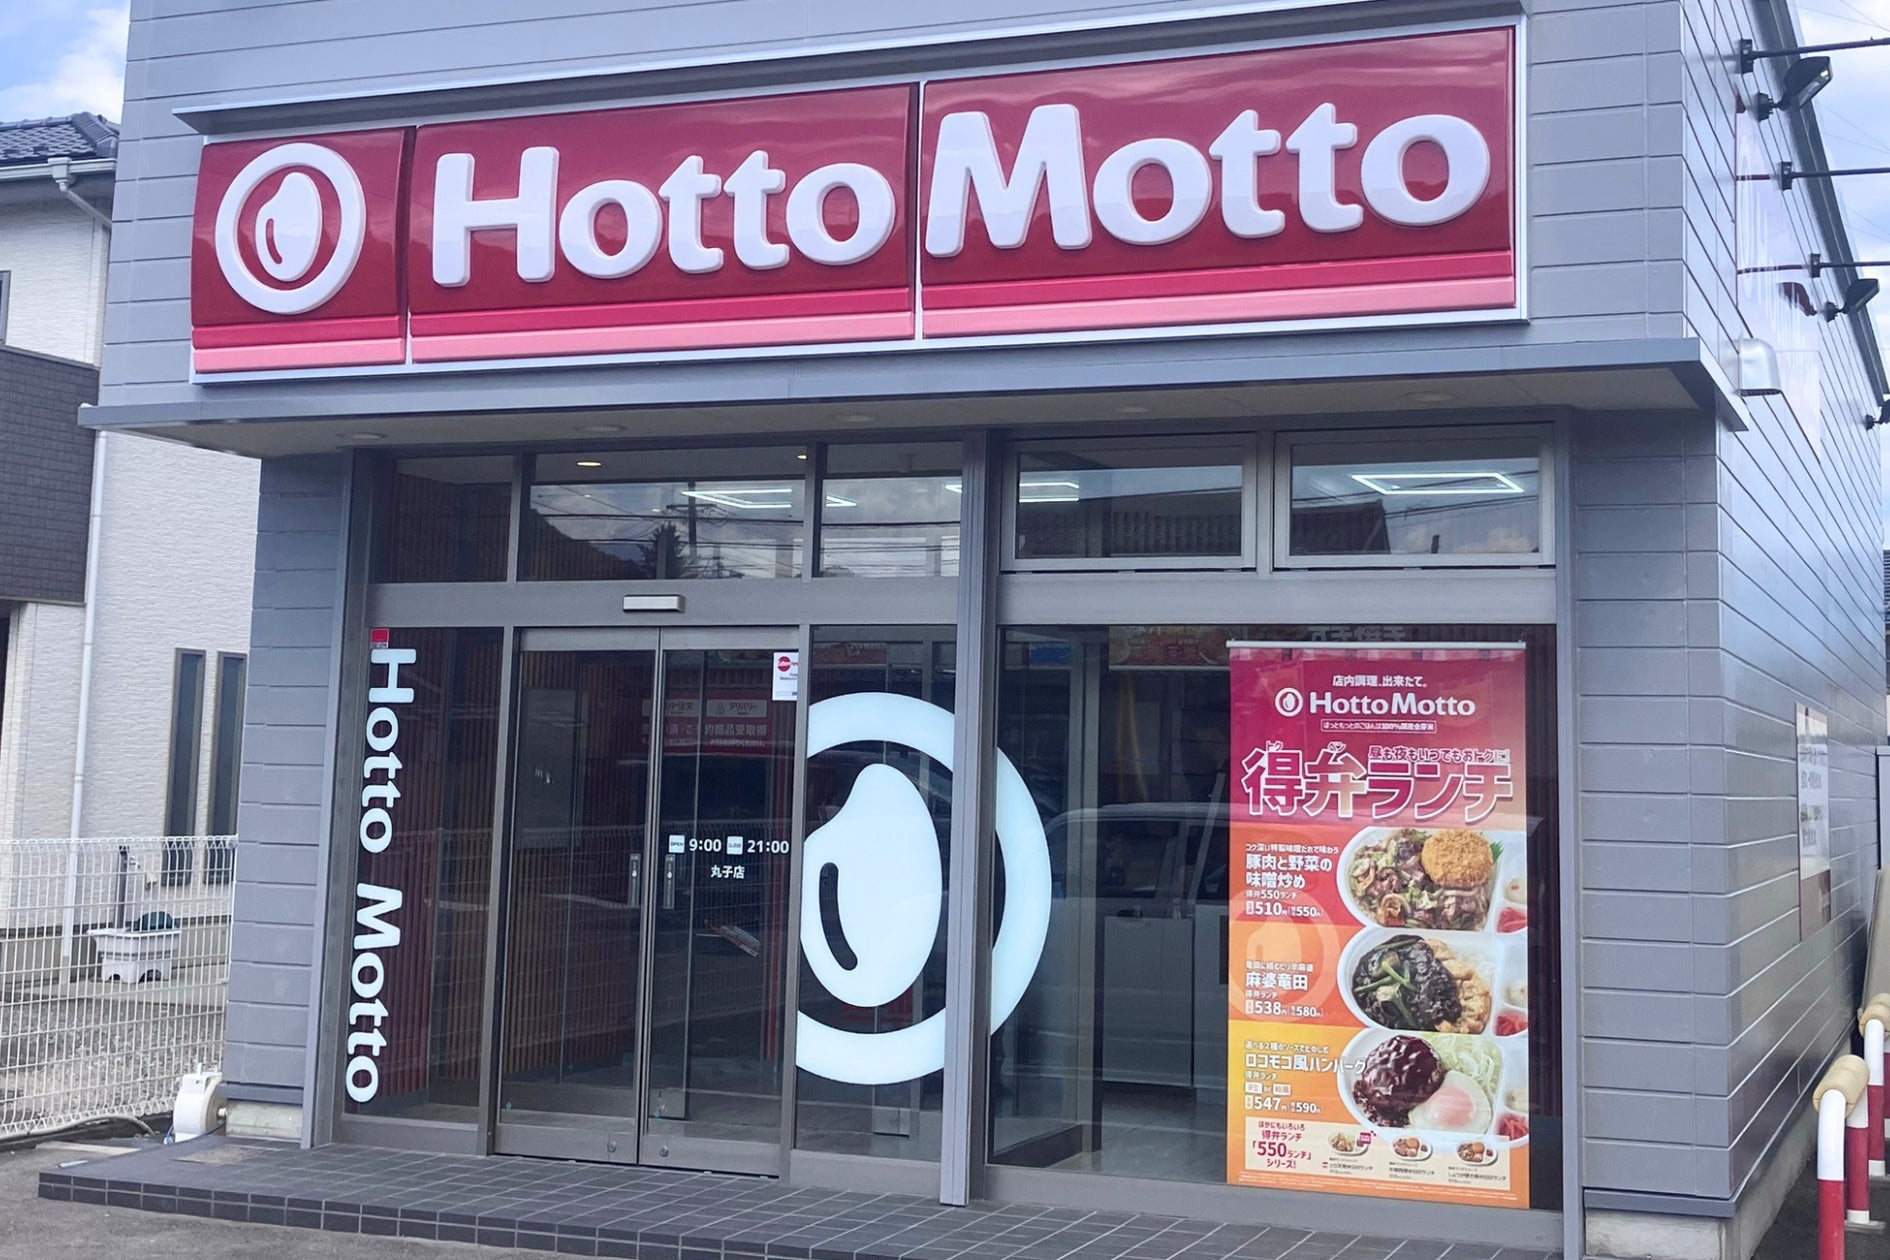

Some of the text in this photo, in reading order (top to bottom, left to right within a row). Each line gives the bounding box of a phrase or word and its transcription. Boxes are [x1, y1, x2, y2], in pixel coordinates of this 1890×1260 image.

[432, 102, 1491, 288] Hotto Motto
[1310, 692, 1476, 716] Hotto Motto
[1241, 748, 1513, 823] 得弁ランチ
[689, 838, 722, 852] 9:00
[747, 839, 789, 854] 21:00
[1246, 853, 1332, 872] 豚肉と野菜の
[345, 648, 417, 1102] Hotto Motto
[710, 865, 745, 880] 丸子店
[1246, 871, 1305, 888] 味噌炒め
[1246, 972, 1308, 990] 麻婆竜田
